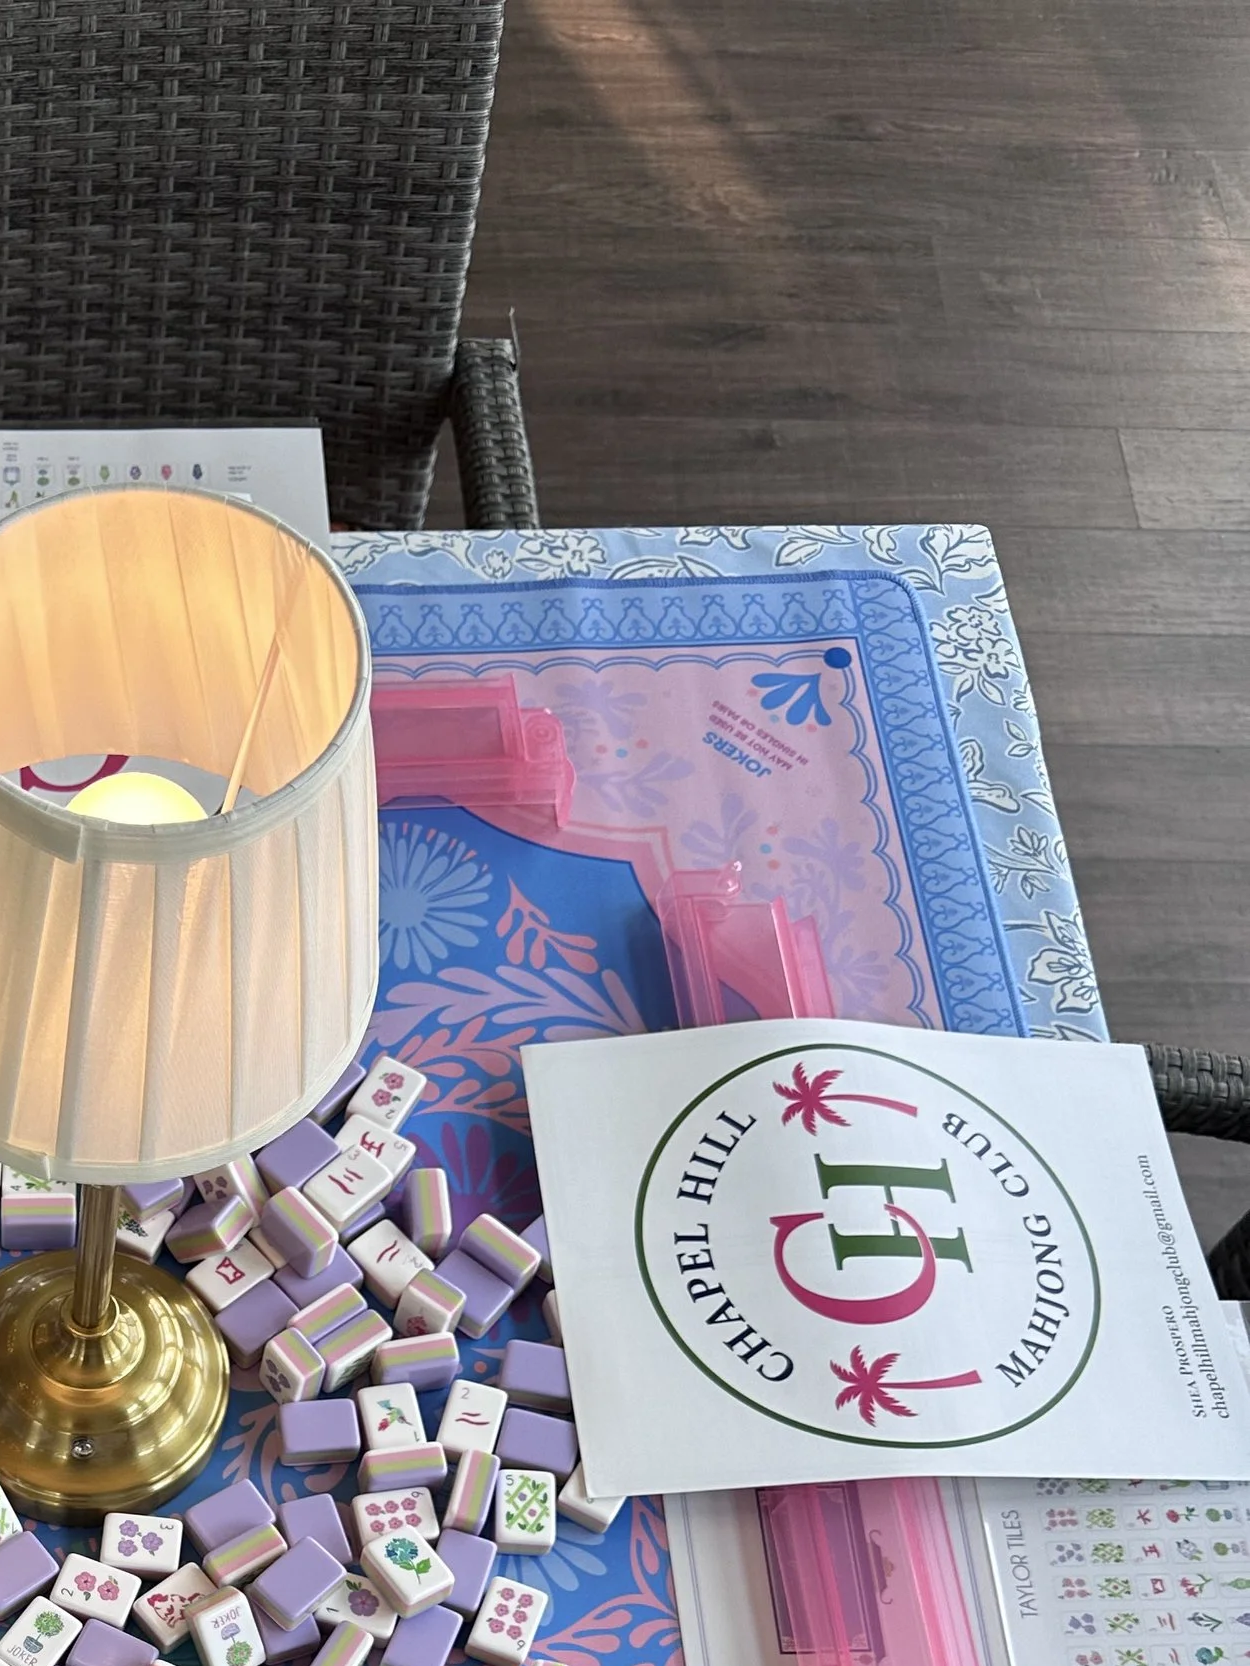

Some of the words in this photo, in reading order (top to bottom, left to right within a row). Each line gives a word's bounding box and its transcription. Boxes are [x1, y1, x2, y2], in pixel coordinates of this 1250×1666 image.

[709, 714, 734, 733] USED
[712, 700, 741, 721] PAIRS
[702, 731, 772, 777] JOKERS
[734, 730, 748, 742] BE
[746, 739, 770, 757] NOT
[756, 728, 797, 758] SINGLES
[769, 754, 793, 771] MAY
[677, 1111, 756, 1204] HILL
[943, 1114, 1028, 1197] CLUB
[674, 1224, 793, 1381] CHAPEL
[996, 1216, 1069, 1387] MAHJONG
[1138, 1154, 1230, 1419] chapelhillmahjongclub@gmail.com
[1001, 1510, 1024, 1549] TILES
[1010, 1554, 1037, 1617] TAYLOR
[211, 1605, 243, 1632] JOKER
